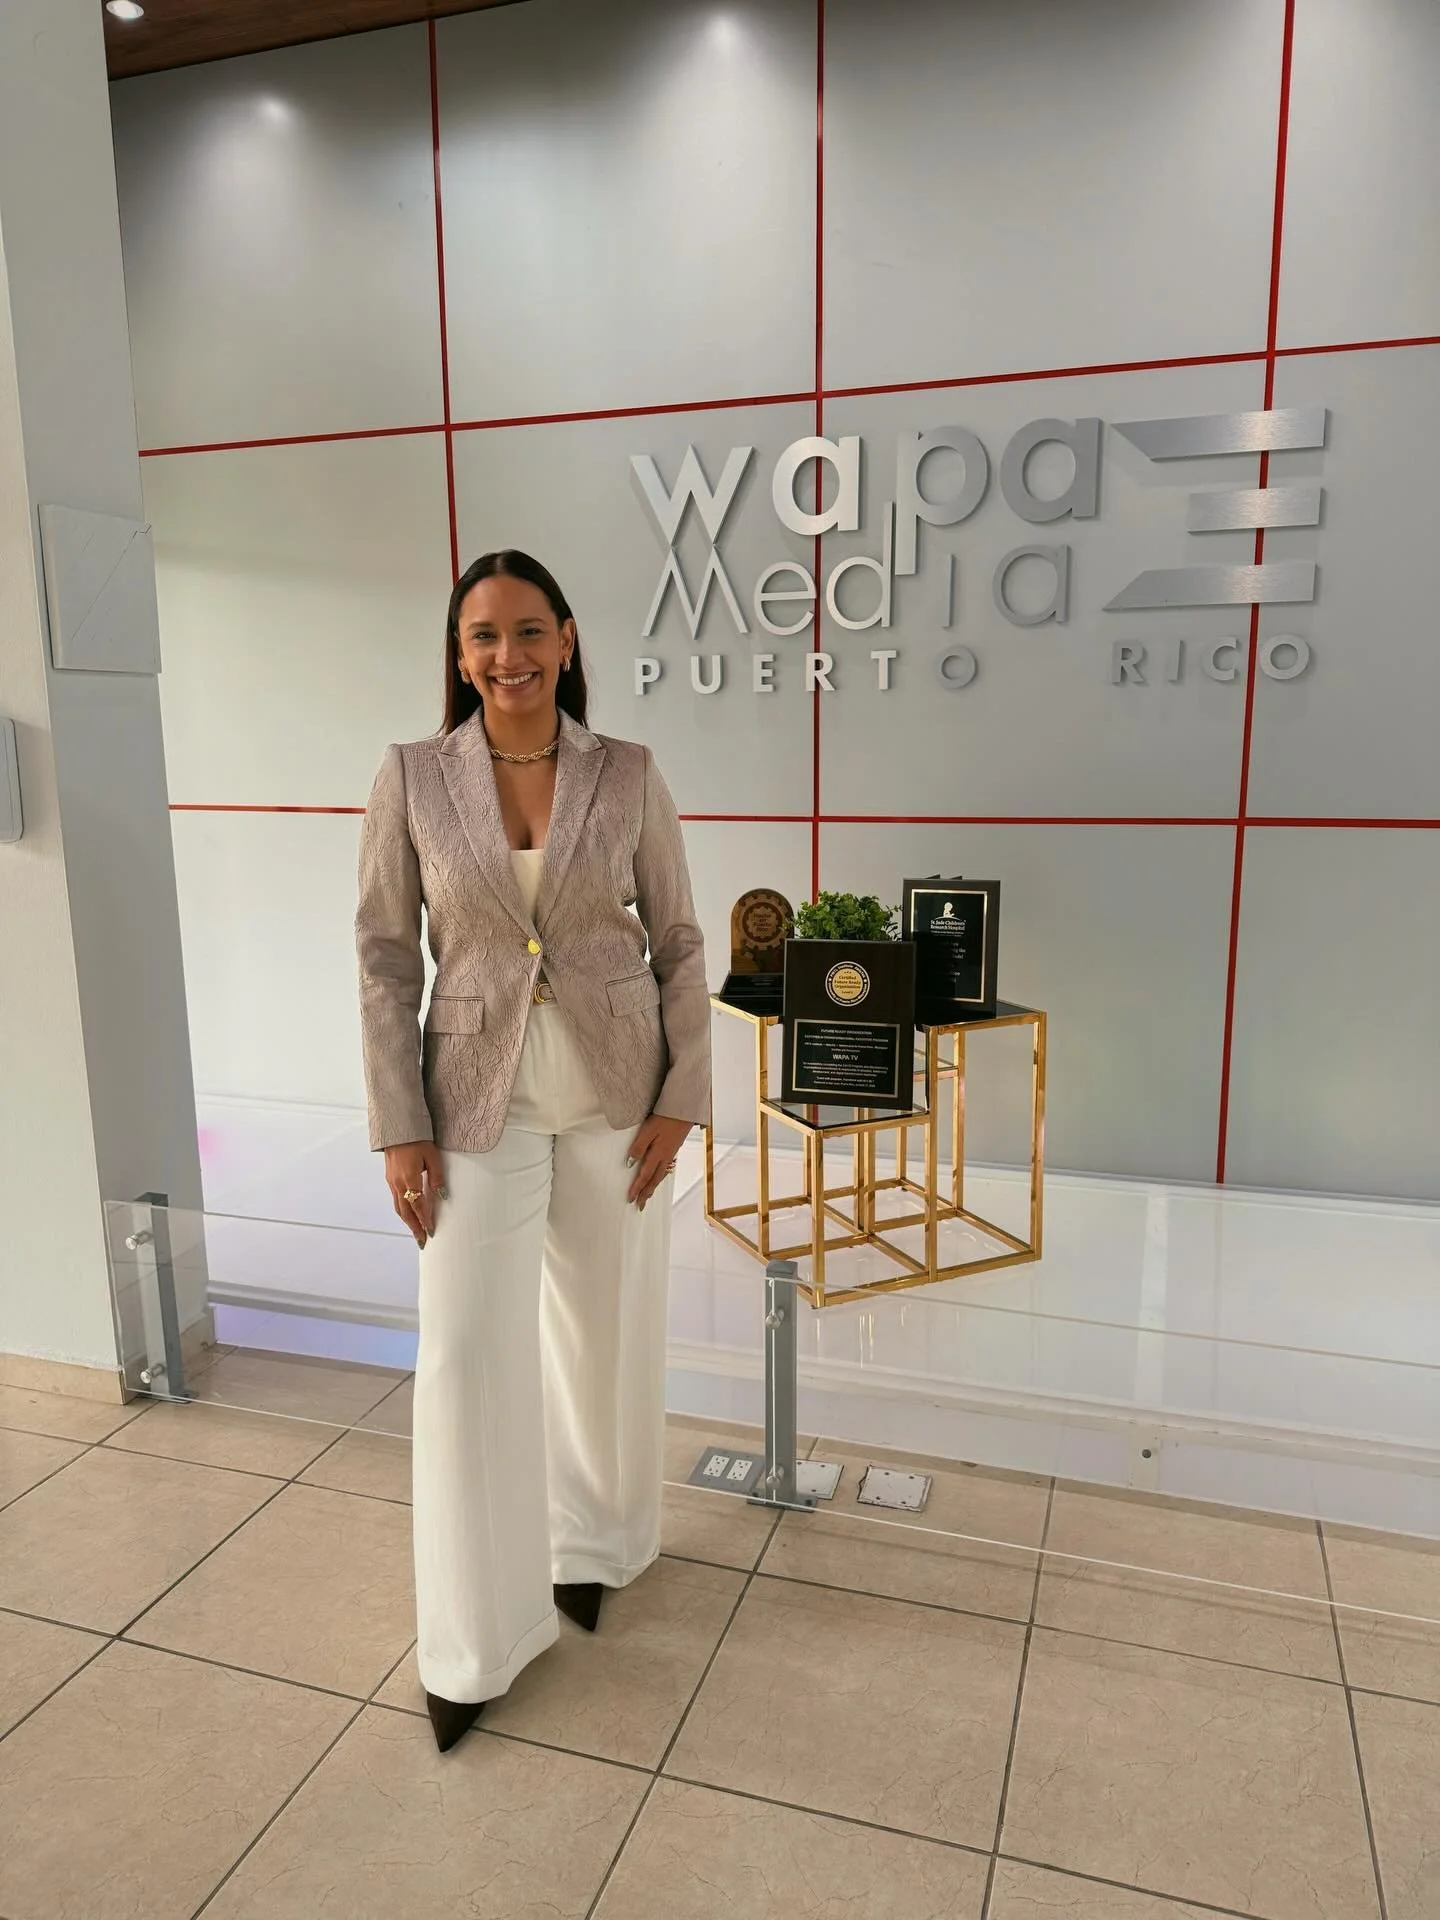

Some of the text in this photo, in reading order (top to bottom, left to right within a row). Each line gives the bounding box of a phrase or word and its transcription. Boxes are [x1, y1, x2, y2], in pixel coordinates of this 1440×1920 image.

[641, 501, 1071, 639] Media
[634, 633, 1312, 696] PUERTO RICO
[832, 1053, 850, 1061] WAPA
